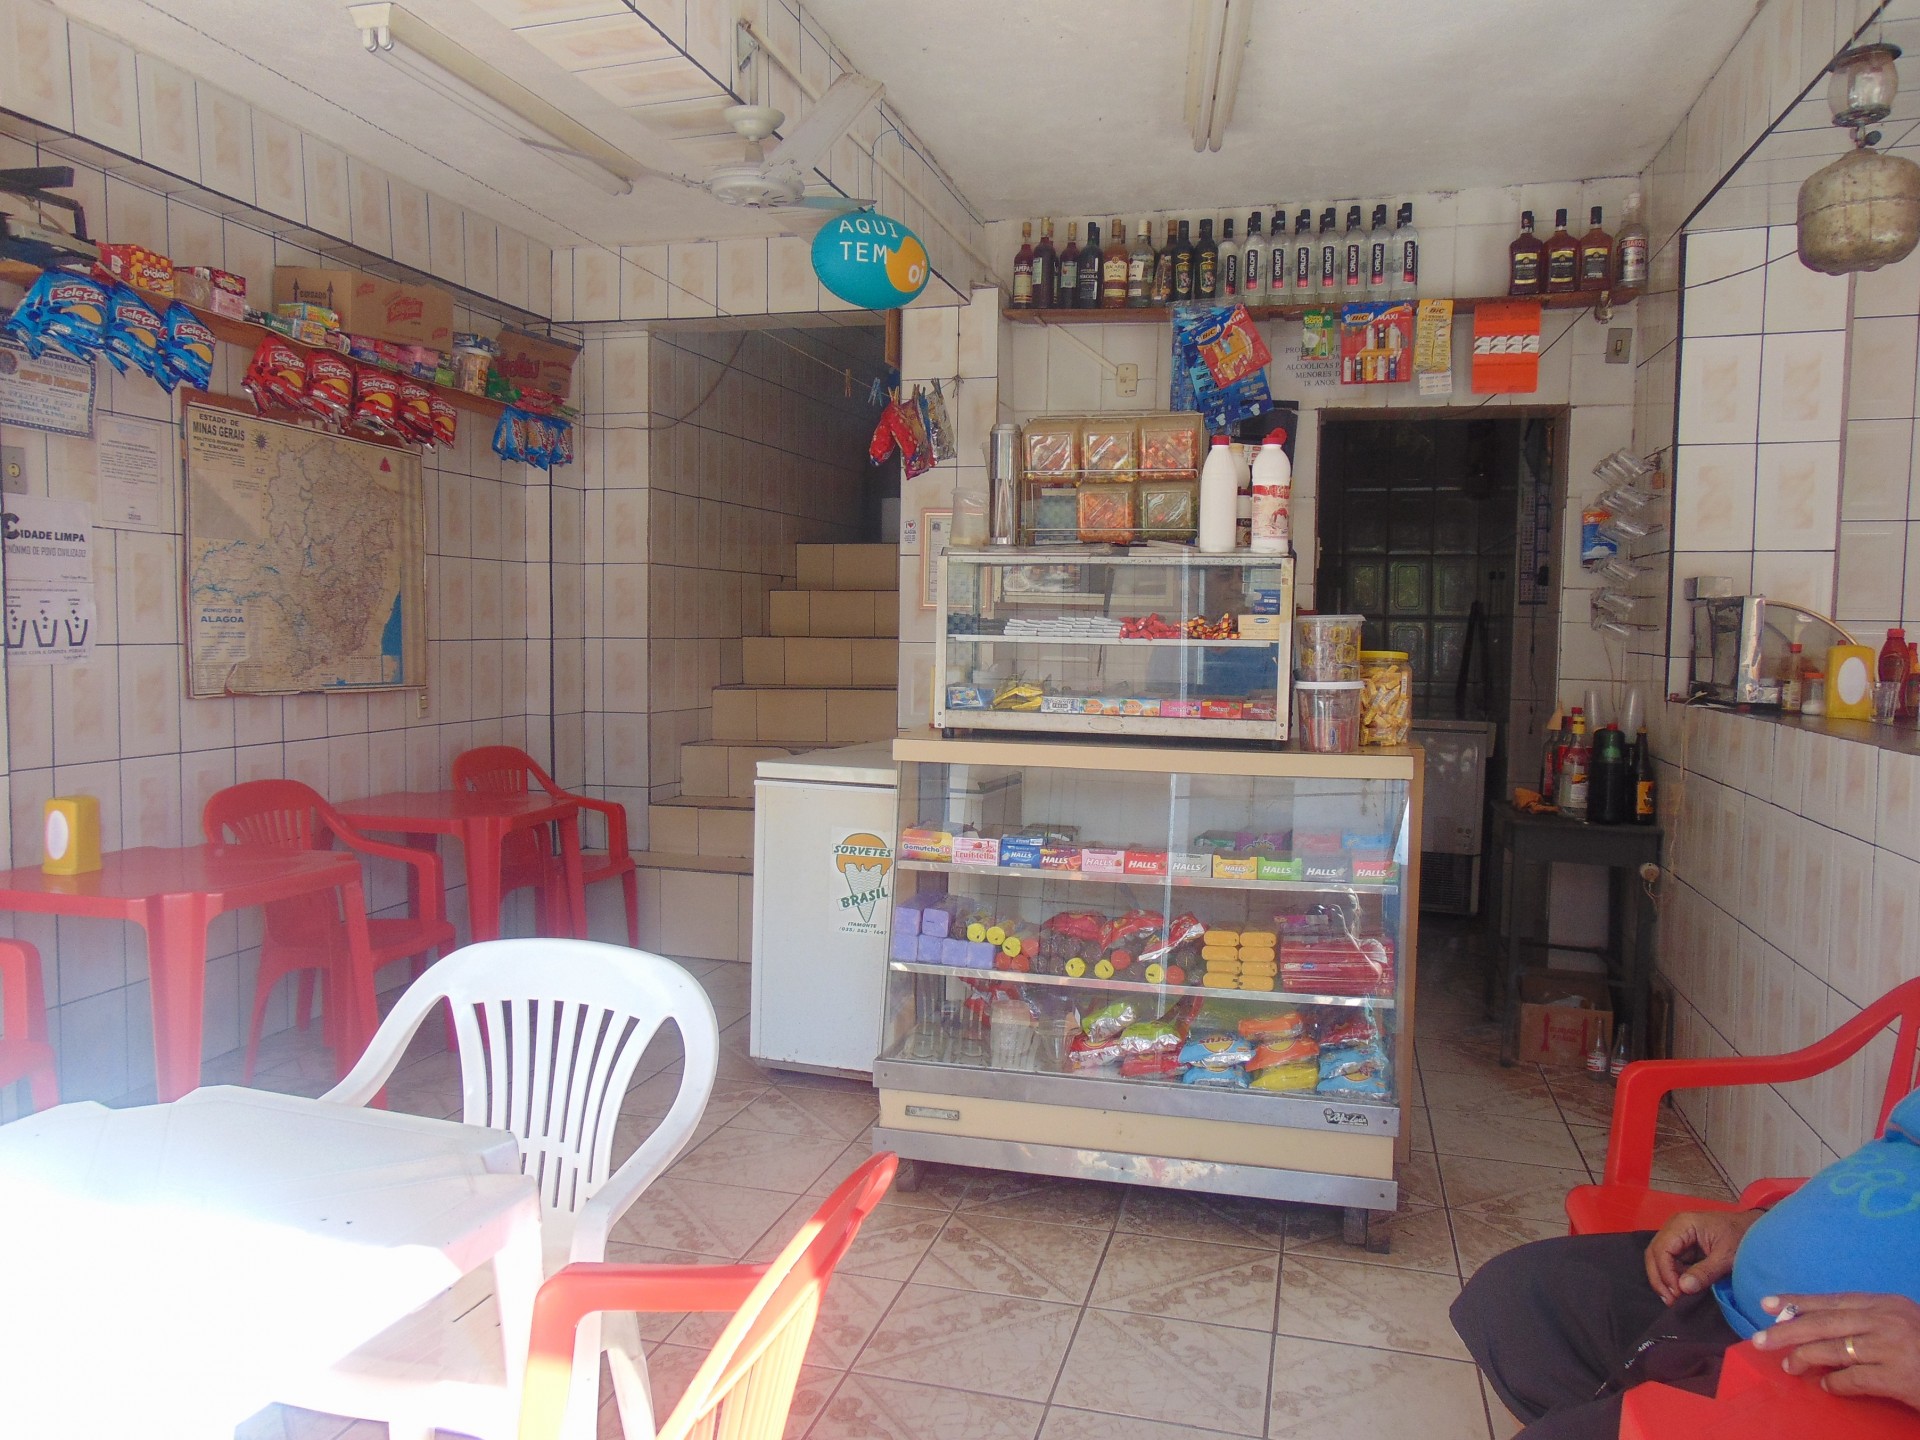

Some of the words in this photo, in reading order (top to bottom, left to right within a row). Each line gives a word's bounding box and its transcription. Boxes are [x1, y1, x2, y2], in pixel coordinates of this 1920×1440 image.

[839, 218, 899, 239] AQUI
[839, 241, 888, 265] TEM
[56, 287, 104, 303] Seleção
[121, 308, 160, 327] Seleção
[1351, 313, 1369, 321] BIC
[181, 325, 216, 343] Seleção
[274, 352, 304, 368] Seleção
[318, 365, 351, 378] Seleção
[362, 380, 395, 390] Seleção
[199, 413, 227, 424] ESTADO
[193, 421, 217, 436] MINAS
[219, 426, 245, 441] GERAIS
[2, 512, 53, 540] CIDADE
[55, 531, 86, 543] LIMPA
[201, 615, 244, 623] ALAGOA
[833, 845, 894, 858] SORVETES
[1010, 851, 1033, 859] HALLS
[1041, 855, 1069, 864] HALLS
[1086, 858, 1114, 866] HALLS
[1128, 860, 1158, 869] HALLS
[1172, 862, 1201, 871] HALLS
[1262, 865, 1292, 874] HALLS
[1306, 867, 1337, 876] HALLS
[1356, 869, 1387, 877] HALLS
[840, 886, 889, 908] BRASIL
